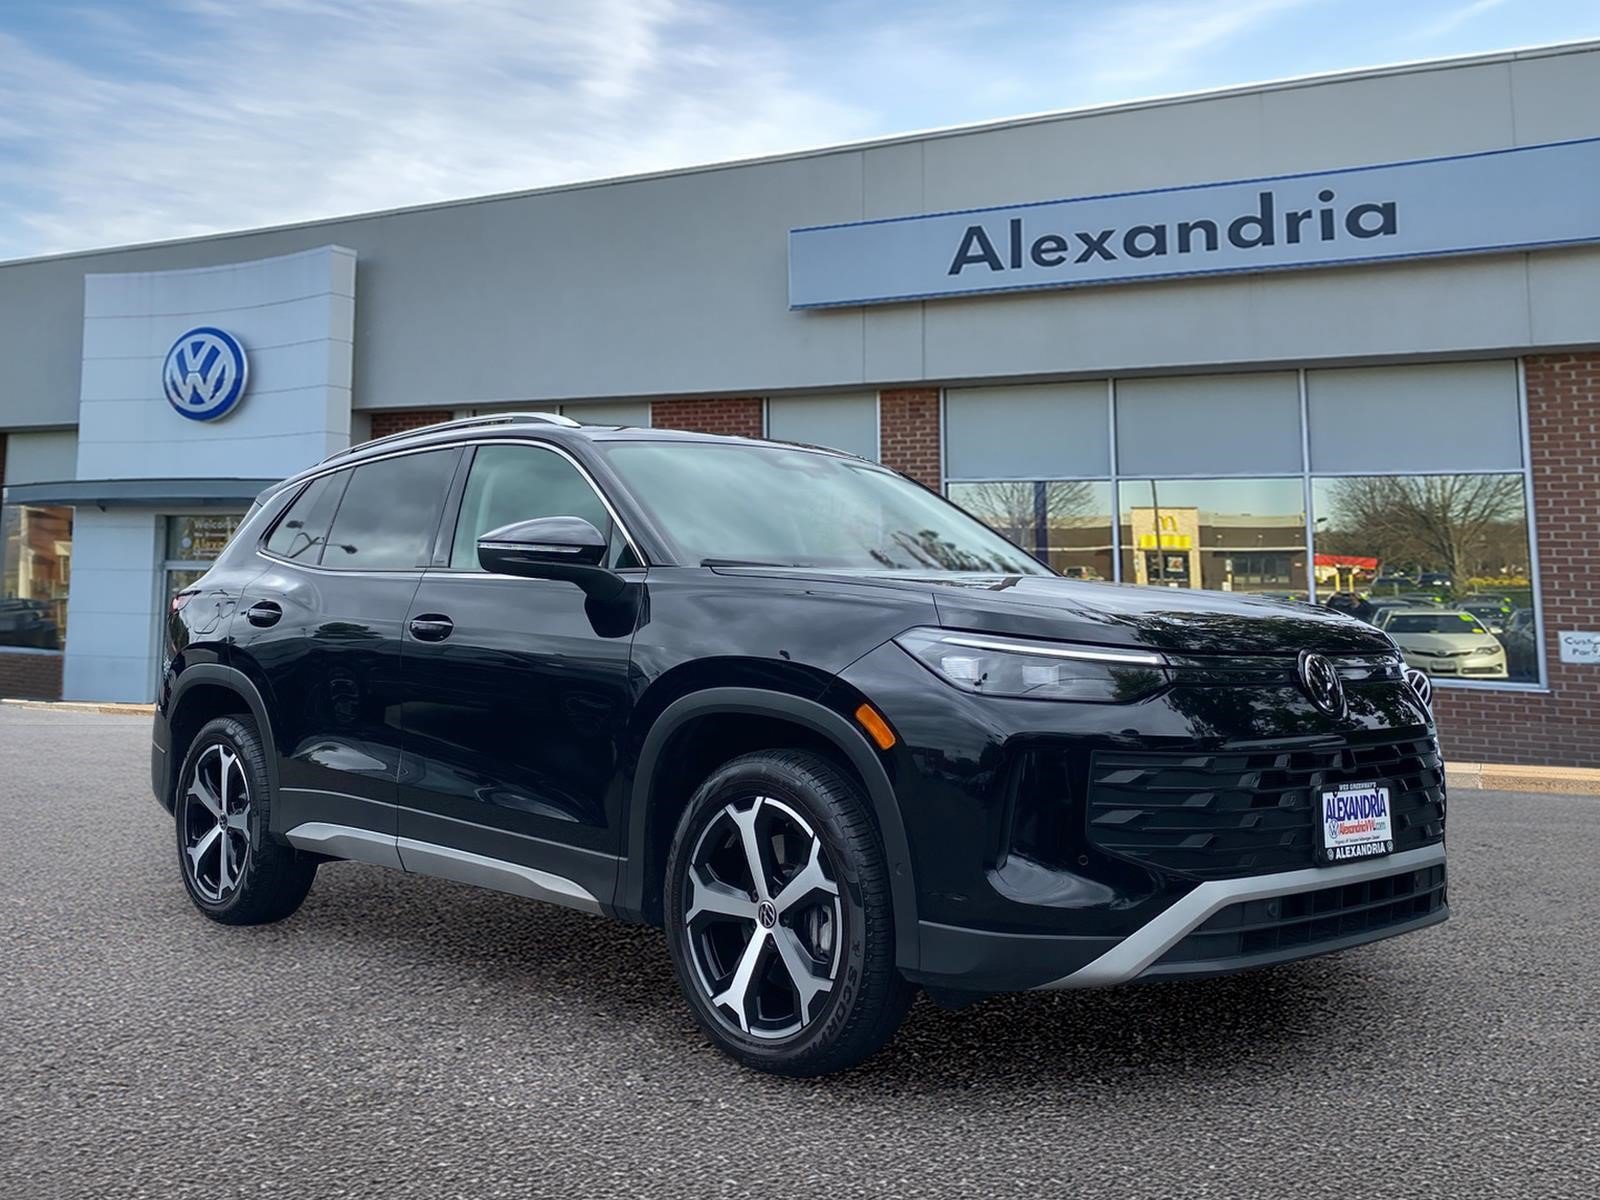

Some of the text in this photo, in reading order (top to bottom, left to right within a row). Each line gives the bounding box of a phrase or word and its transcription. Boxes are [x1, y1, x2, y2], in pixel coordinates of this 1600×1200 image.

[948, 189, 1397, 275] Alexandria
[165, 331, 239, 414] VW
[1325, 793, 1388, 824] ALEXANDRIA
[1335, 842, 1387, 861] ALEXANDRIA
